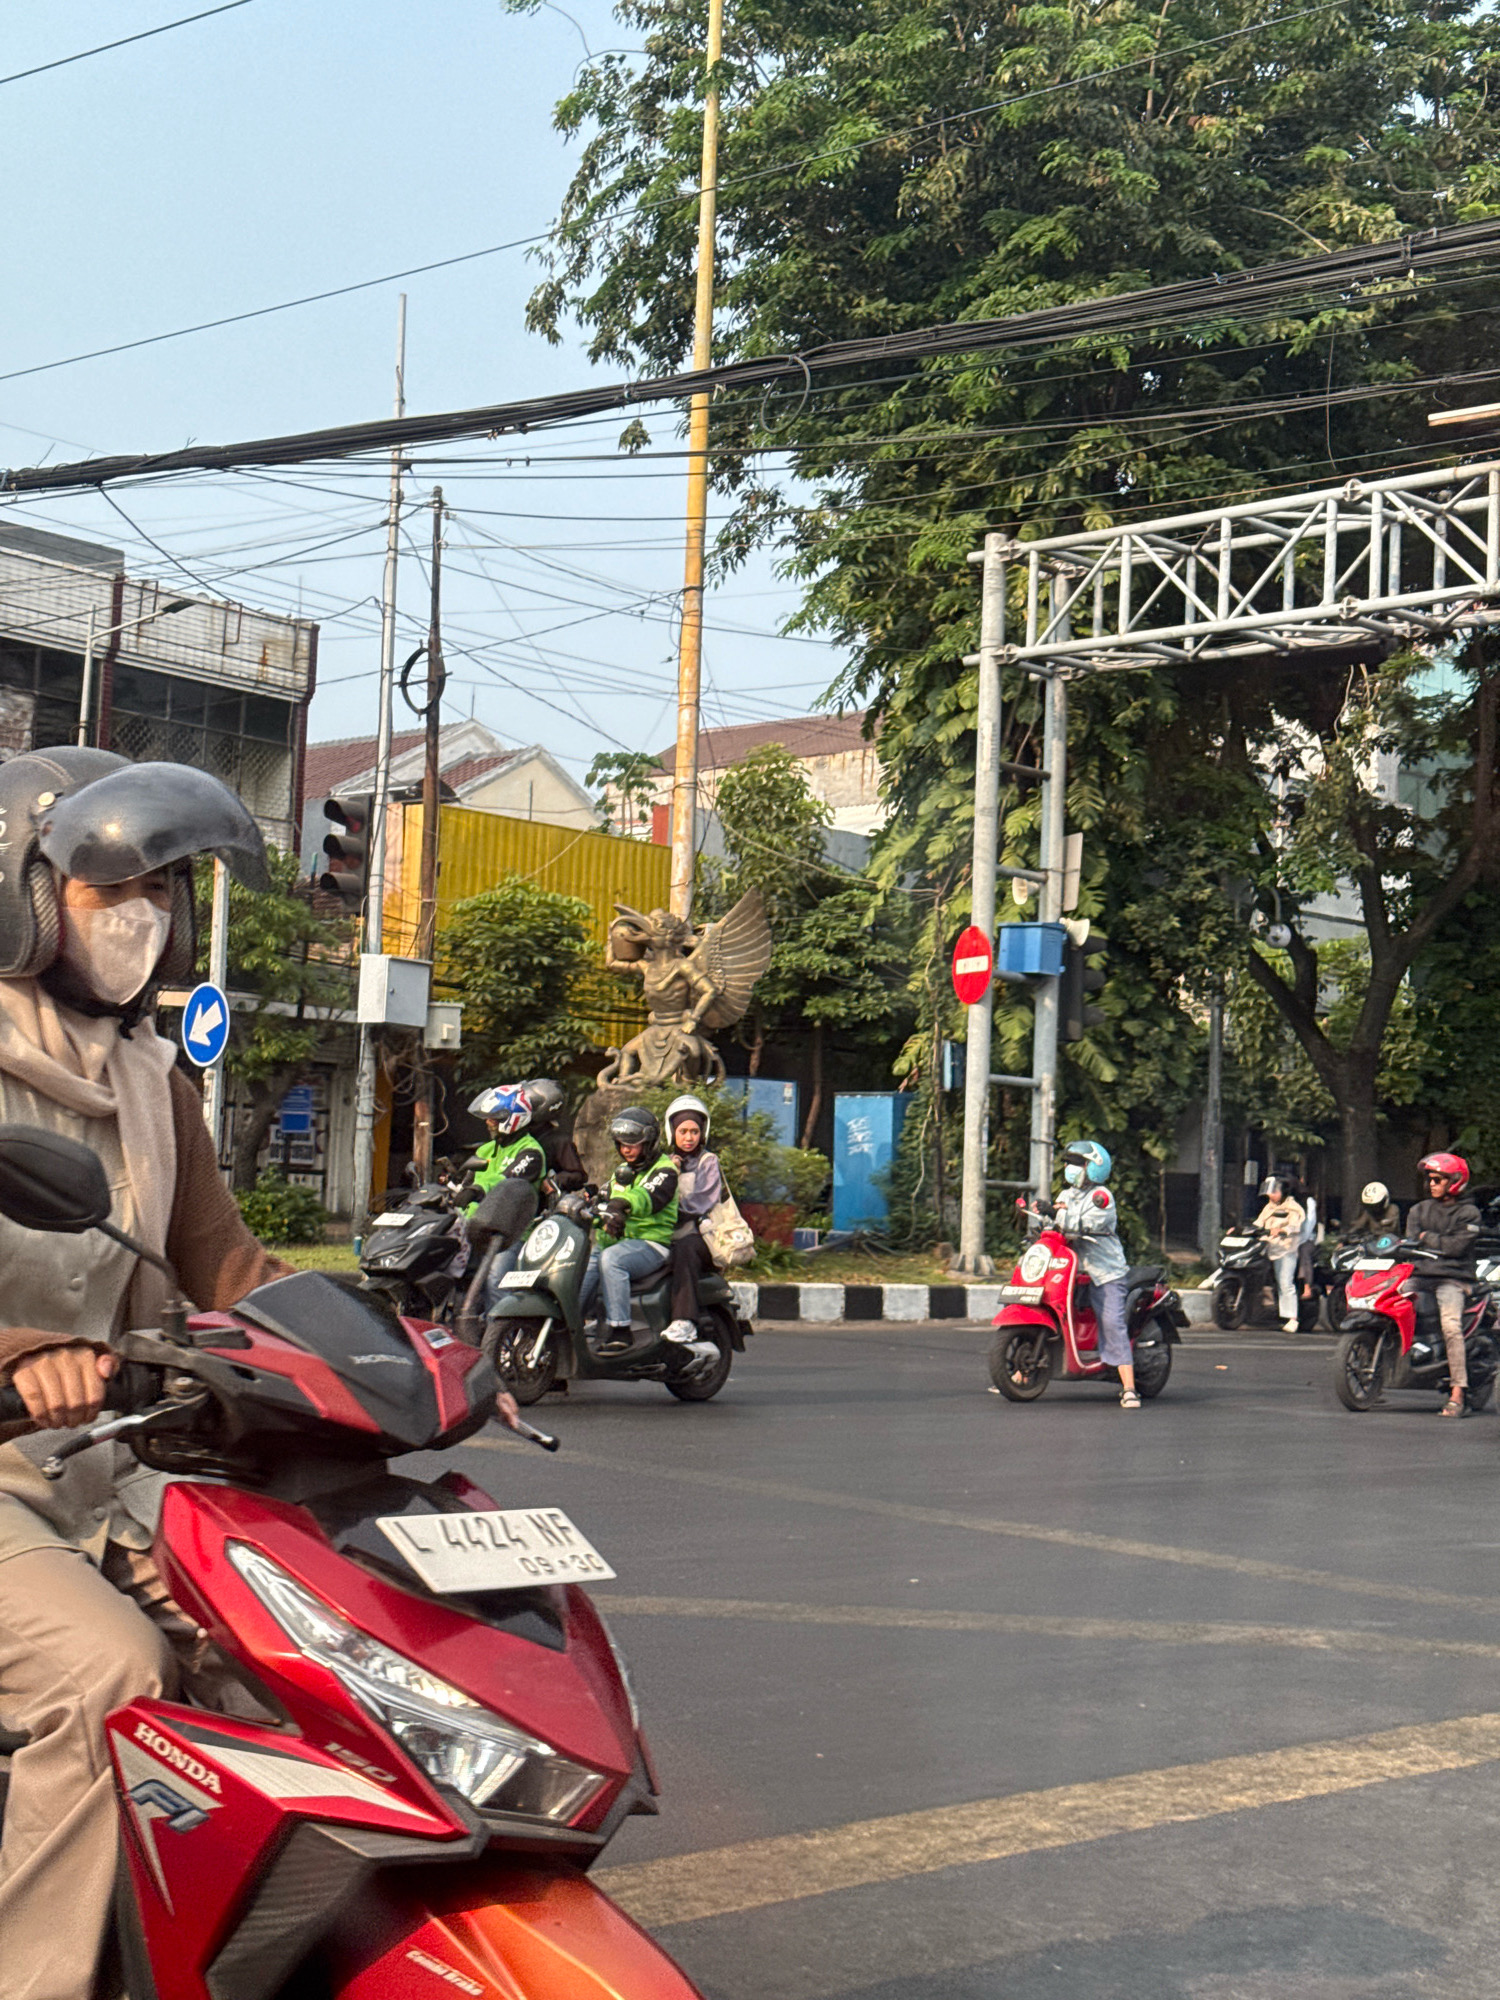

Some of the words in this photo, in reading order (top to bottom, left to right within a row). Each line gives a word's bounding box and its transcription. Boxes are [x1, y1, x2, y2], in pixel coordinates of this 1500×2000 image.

[393, 1520, 434, 1553] L
[438, 1514, 530, 1552] 4424
[525, 1512, 576, 1547] NF
[133, 1721, 223, 1794] HONDA
